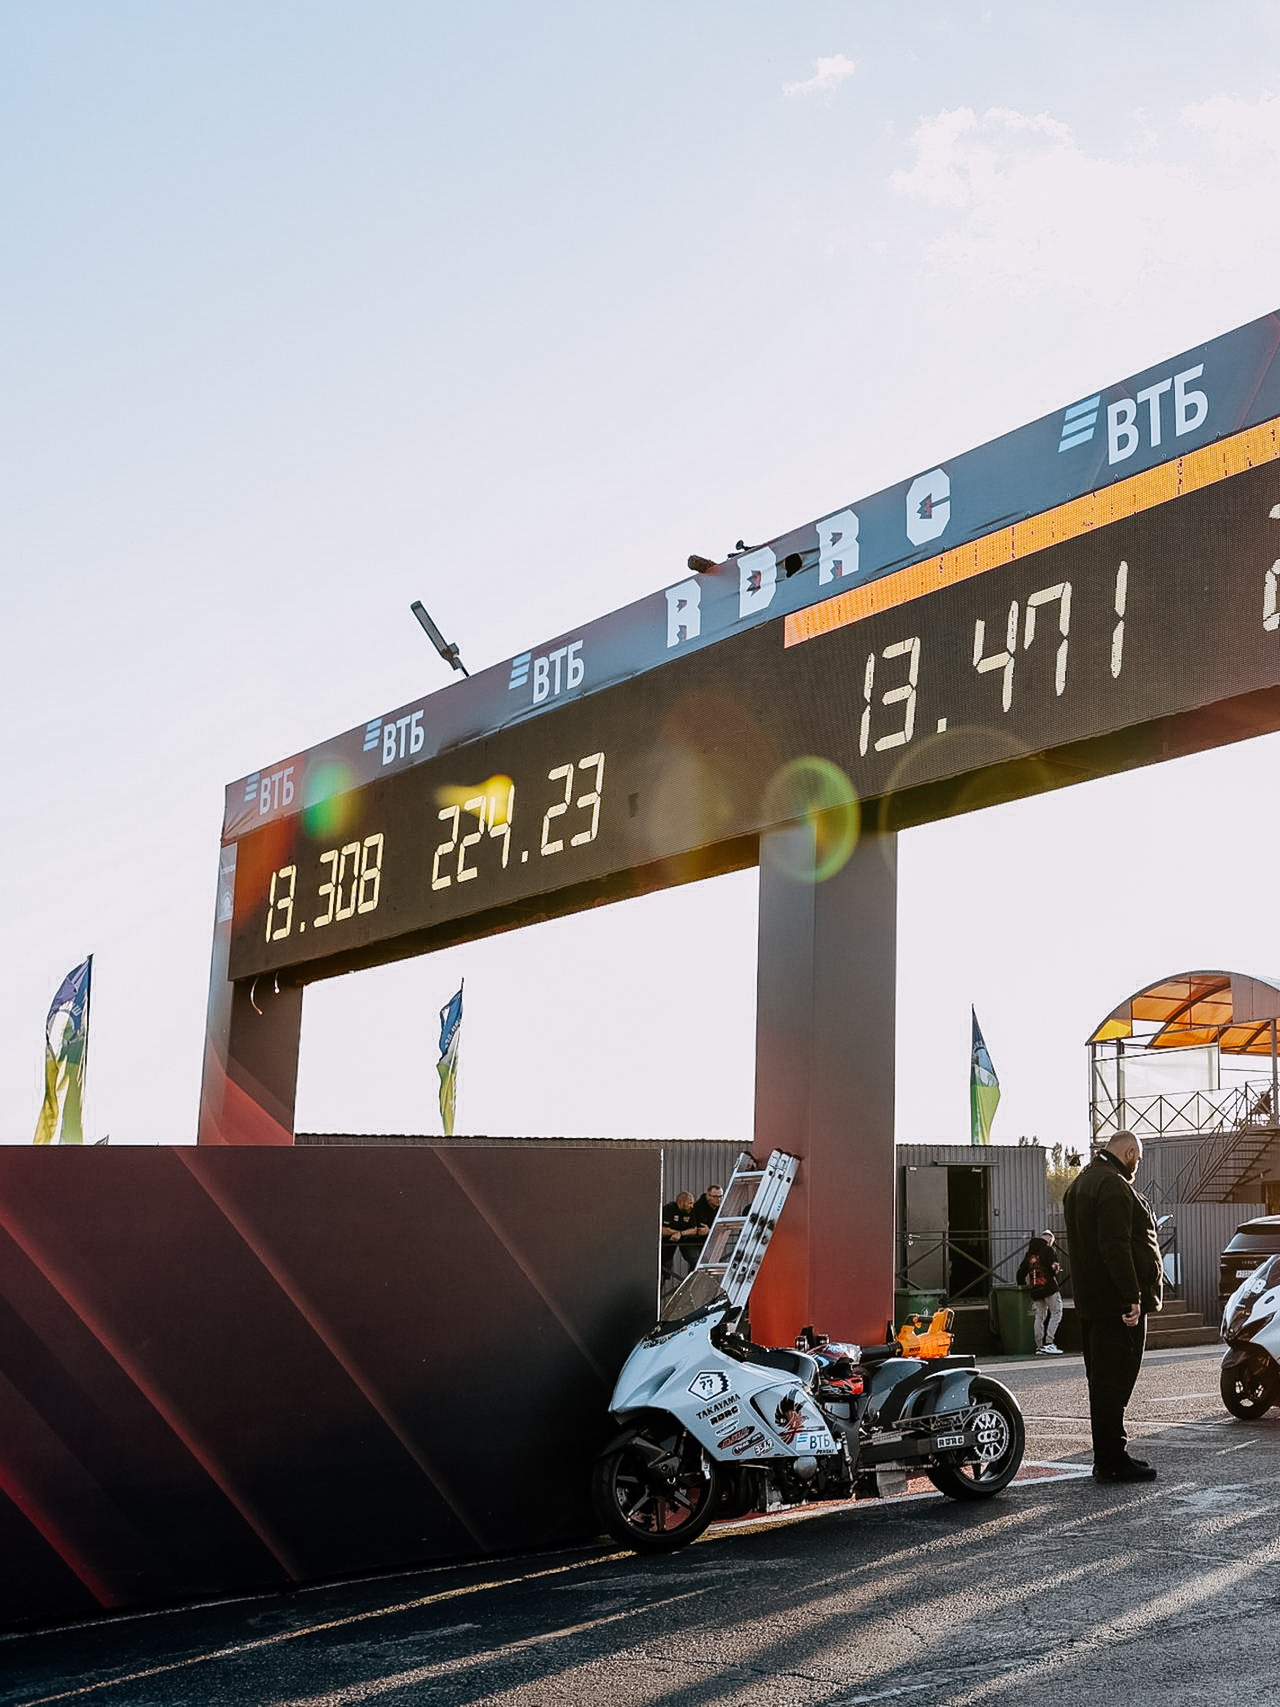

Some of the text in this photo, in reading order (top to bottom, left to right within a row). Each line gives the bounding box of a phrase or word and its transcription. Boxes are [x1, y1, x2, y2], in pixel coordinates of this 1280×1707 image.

[1107, 363, 1209, 466] ВТБ
[532, 639, 585, 704] ВТБ
[381, 709, 425, 766] ВТБ
[259, 766, 295, 816] ВТБ
[431, 751, 605, 891] 224.23
[265, 832, 385, 943] 13.308
[696, 1394, 741, 1420] TAKAYAMA
[709, 1405, 739, 1425] RDRC
[809, 1434, 831, 1450] ВТБ
[938, 1436, 963, 1447] RDRC
